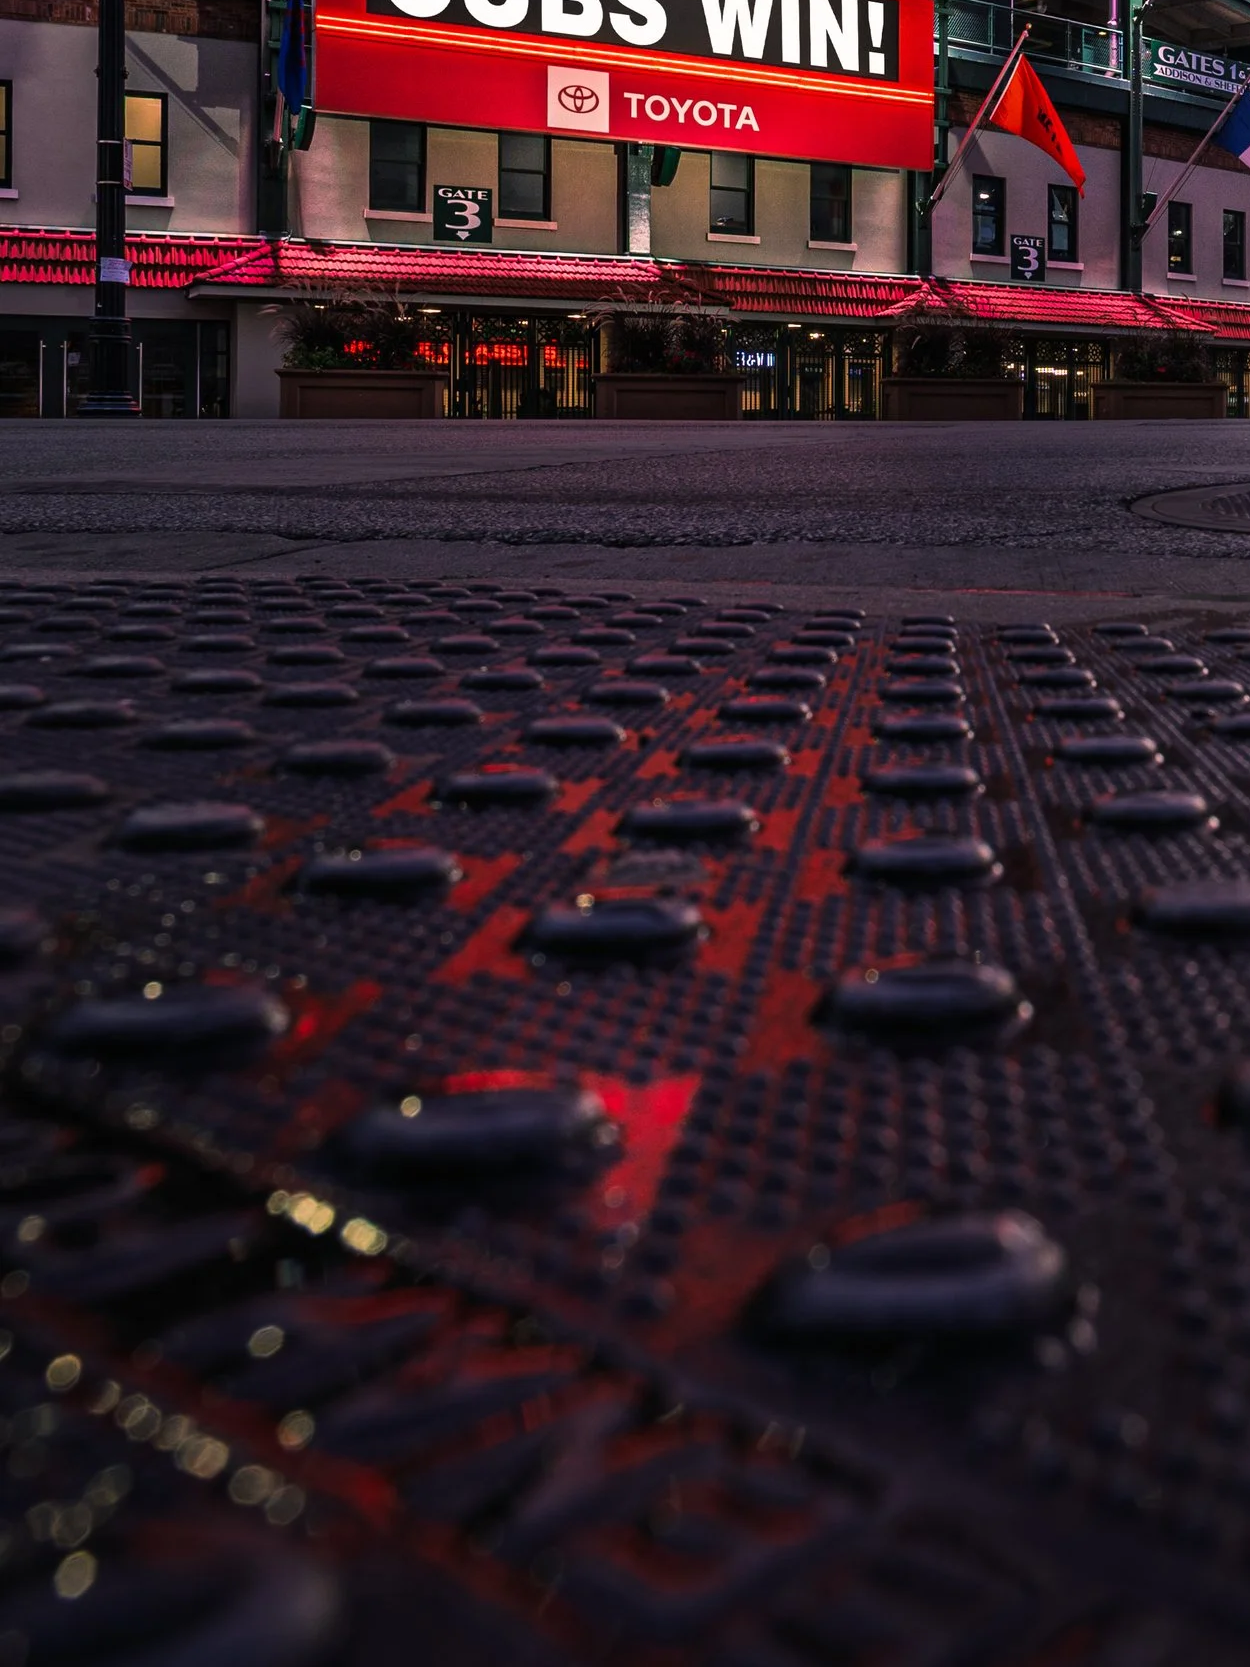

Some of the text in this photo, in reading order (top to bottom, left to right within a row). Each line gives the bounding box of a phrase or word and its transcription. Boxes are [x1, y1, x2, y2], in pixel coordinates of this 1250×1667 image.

[1158, 46, 1225, 76] GATES
[1158, 67, 1202, 84] ADDISON
[1204, 77, 1212, 86] &
[623, 91, 760, 132] TOYOTA
[438, 188, 489, 200] GATE
[445, 199, 481, 229] 3
[1013, 237, 1043, 247] GATE
[1017, 246, 1039, 271] 3
